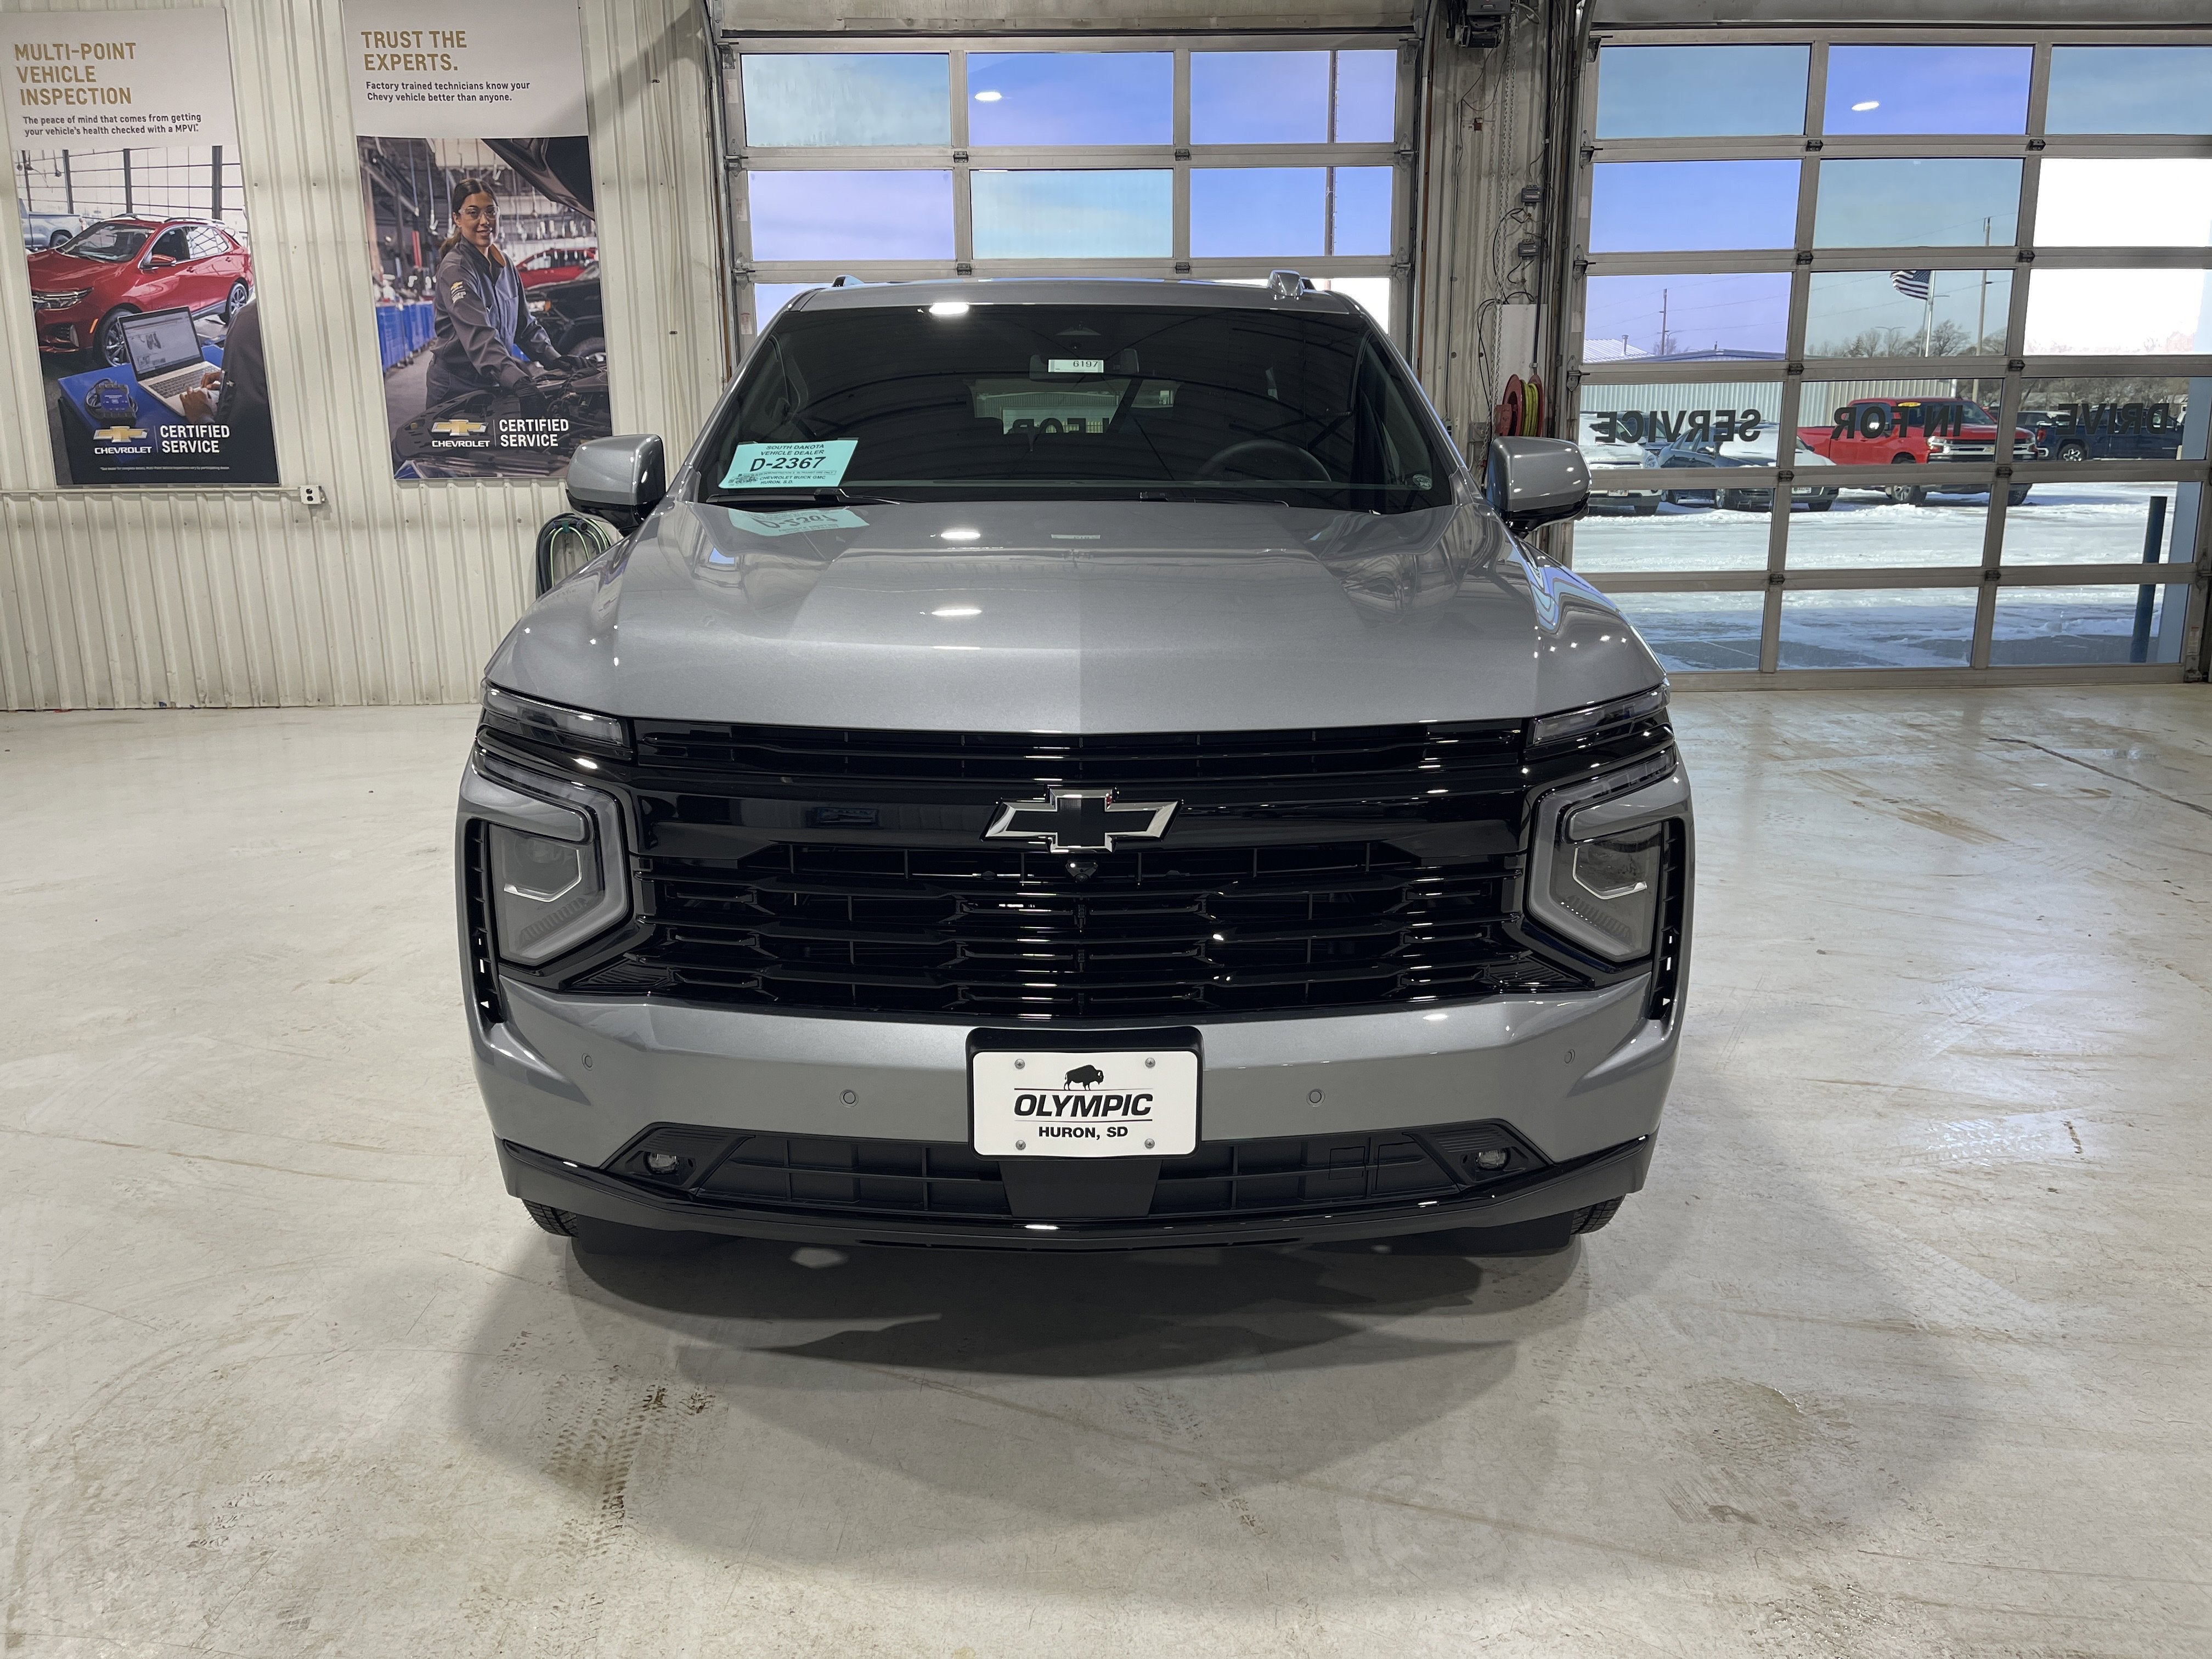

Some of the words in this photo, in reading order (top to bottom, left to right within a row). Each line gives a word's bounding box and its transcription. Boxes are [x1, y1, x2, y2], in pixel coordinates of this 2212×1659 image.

[361, 31, 423, 49] TRUST
[429, 31, 467, 48] THE
[14, 43, 136, 61] MULTI-POINT
[364, 54, 458, 71] EXPERTS.
[16, 65, 97, 83] VEHICLE
[366, 82, 399, 91] Factory
[401, 82, 432, 91] trained
[434, 82, 483, 91] technicians
[510, 83, 530, 91] your
[20, 87, 132, 105] INSPECTION
[368, 93, 393, 102] Chevy
[396, 93, 425, 101] vehicle
[428, 93, 454, 101] better
[479, 94, 512, 103] anyone.
[41, 117, 65, 126] peace
[78, 115, 98, 123] mind
[171, 113, 201, 123] getting
[25, 128, 43, 137] your
[45, 127, 81, 135] vehicle's
[83, 126, 109, 134] health
[111, 126, 145, 134] checked
[160, 425, 230, 438] CERTIFIED
[499, 419, 568, 432] CERTIFIED
[162, 440, 220, 453] SERVICE
[500, 434, 558, 447] SERVICE
[749, 456, 826, 472] D-2367
[1014, 1093, 1153, 1118] OLYMPIC
[1039, 1126, 1099, 1140] HURON,
[1106, 1126, 1128, 1138] SD
